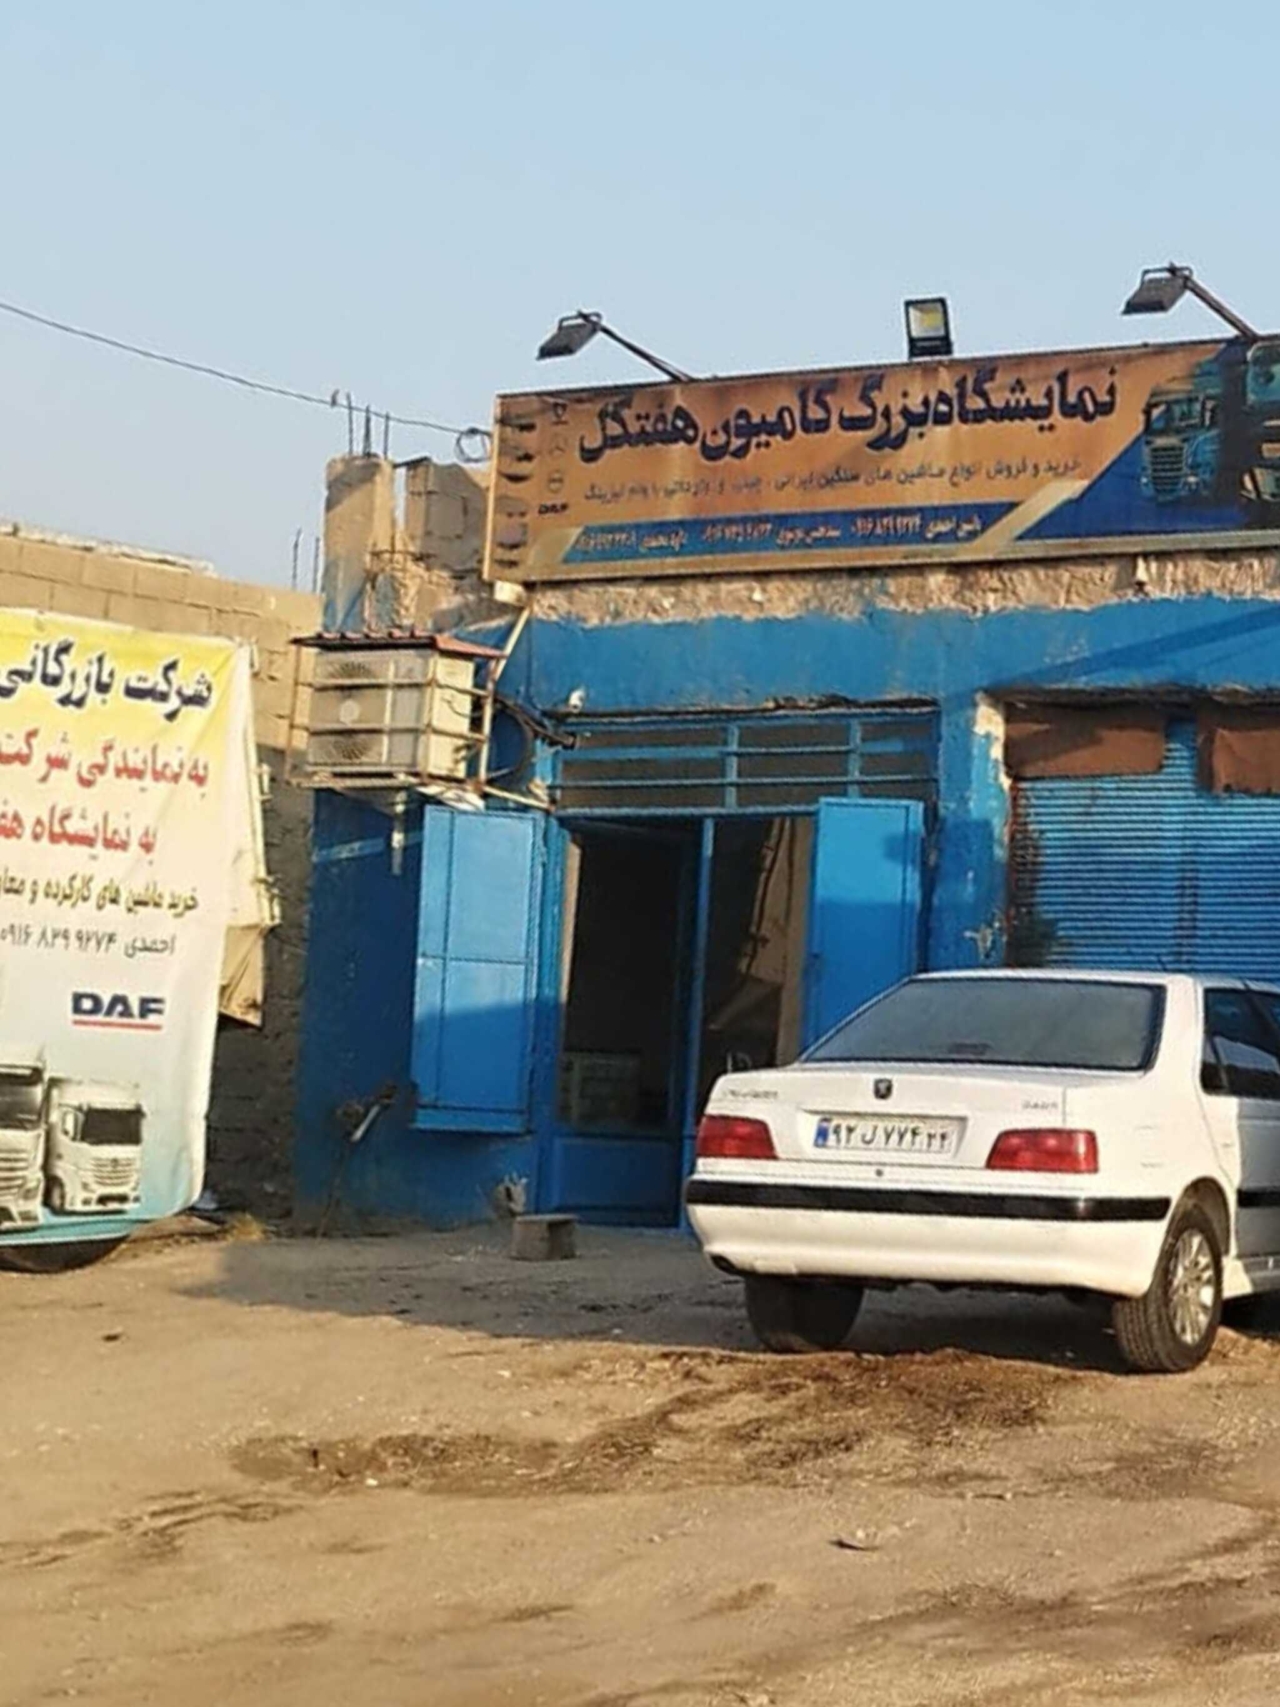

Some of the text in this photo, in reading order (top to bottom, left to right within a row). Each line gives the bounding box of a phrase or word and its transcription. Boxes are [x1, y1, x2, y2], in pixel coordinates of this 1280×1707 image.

[578, 366, 1117, 463] نمایشگاه بزرگ کامیون هفتگل
[818, 465, 860, 489] سنگین
[897, 465, 947, 486] ماشین
[986, 460, 1029, 481] فروش
[1032, 463, 1041, 477] و
[1043, 456, 1081, 476] خرید
[0, 638, 213, 723] شرکت بازرگانی
[76, 737, 185, 793] نمایندگی
[187, 757, 209, 799] به
[31, 804, 131, 861] نمایشگاه
[139, 825, 157, 866] به
[28, 879, 38, 904] و
[44, 873, 94, 909] کارکرده
[96, 877, 120, 910] های
[125, 880, 164, 914] ماشین
[168, 887, 199, 918] خرید
[124, 934, 176, 958] احمدی
[71, 991, 165, 1020] DAF
